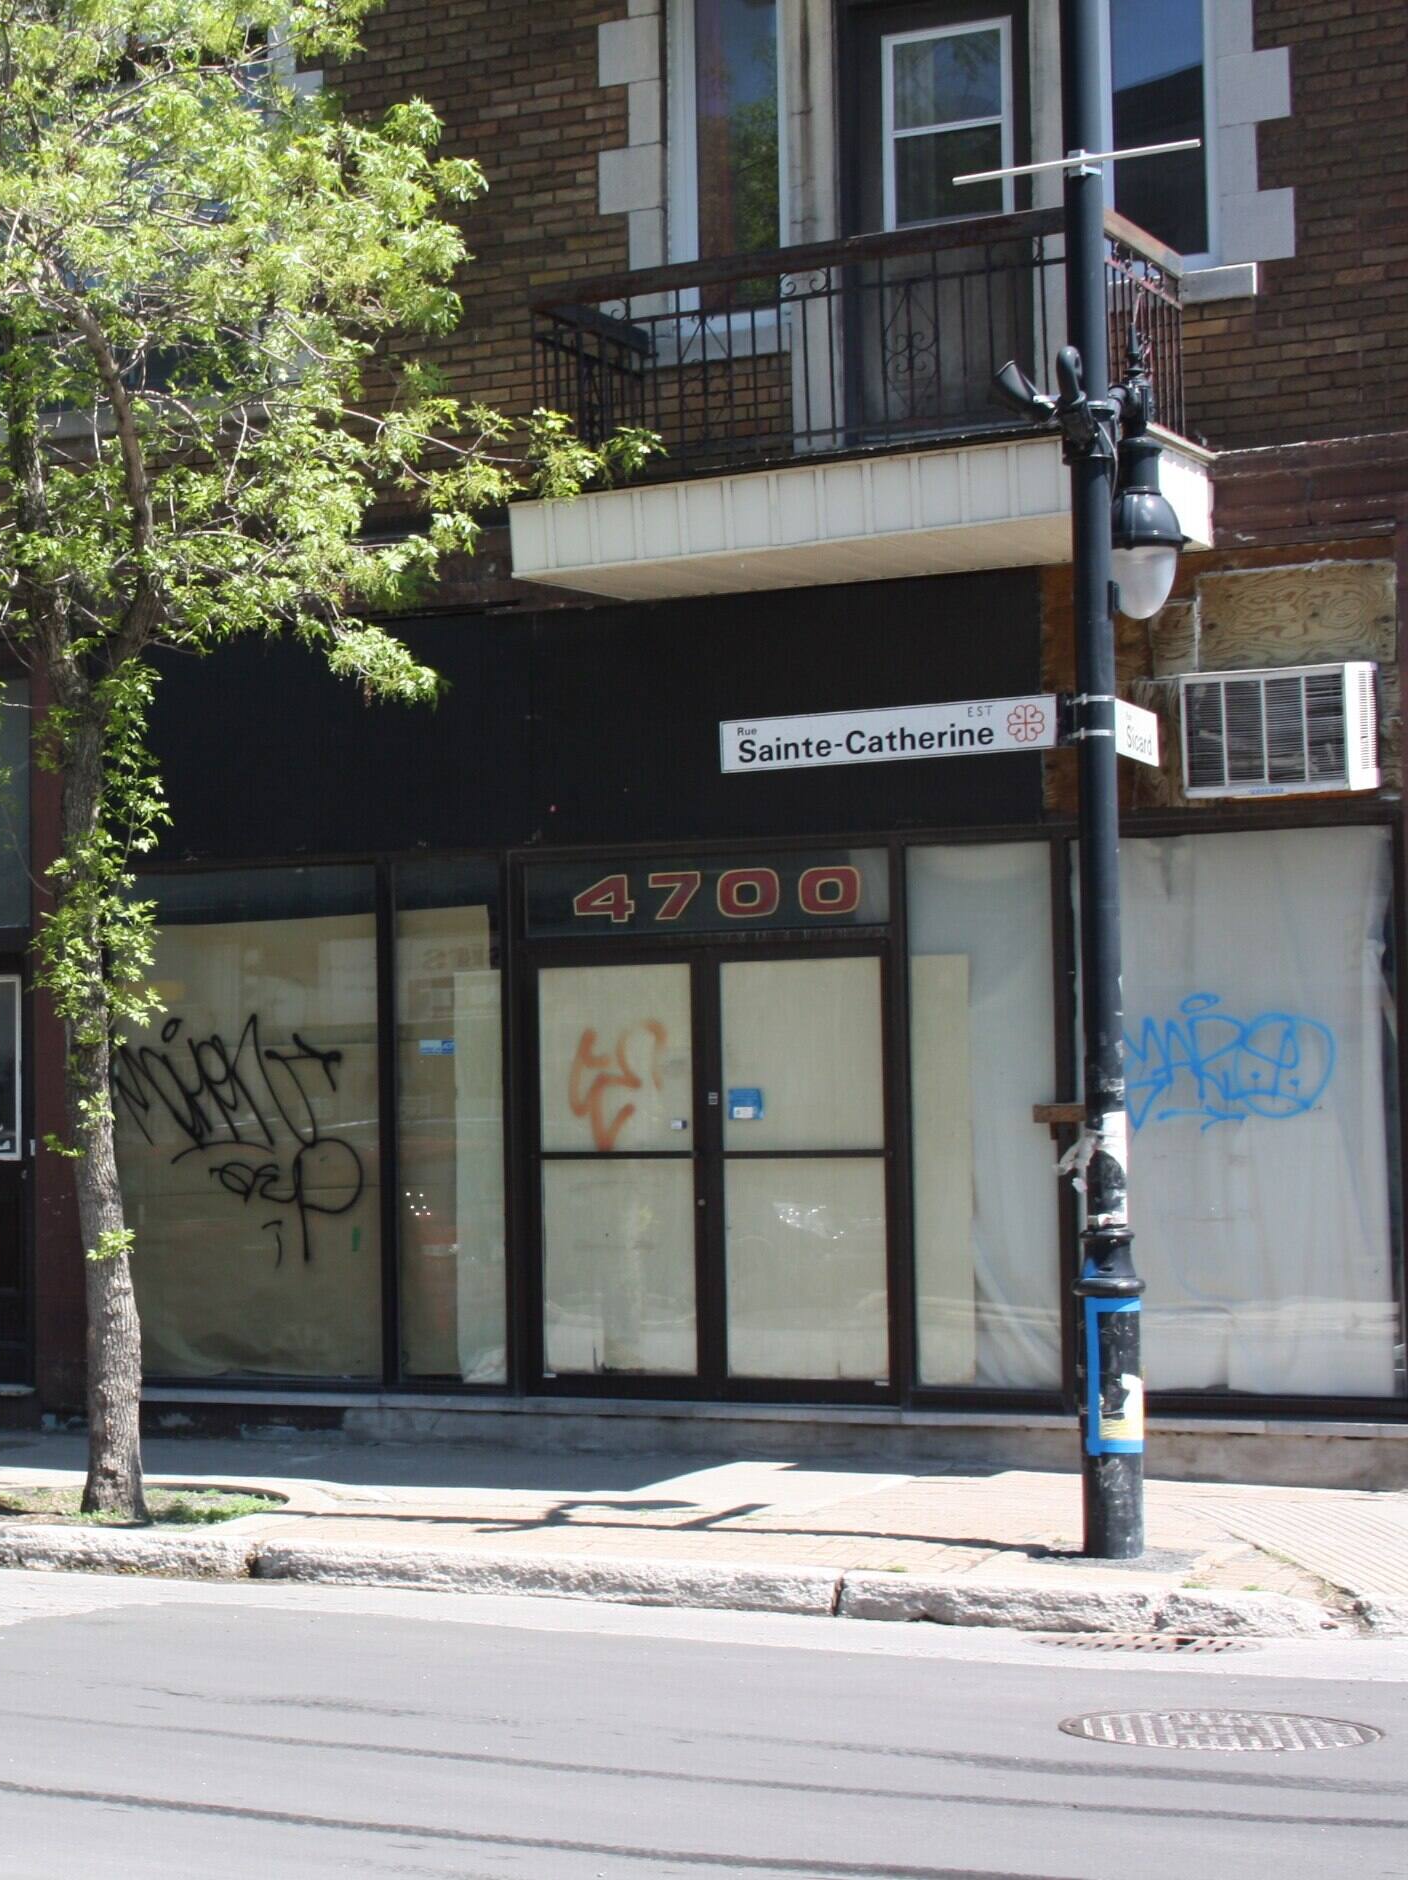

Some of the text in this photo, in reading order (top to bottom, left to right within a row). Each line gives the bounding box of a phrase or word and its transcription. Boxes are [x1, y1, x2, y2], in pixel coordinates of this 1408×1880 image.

[967, 705, 994, 718] EST
[737, 727, 758, 737] Rue
[738, 723, 995, 764] Sainte-Catherine
[573, 865, 860, 923] 4700
